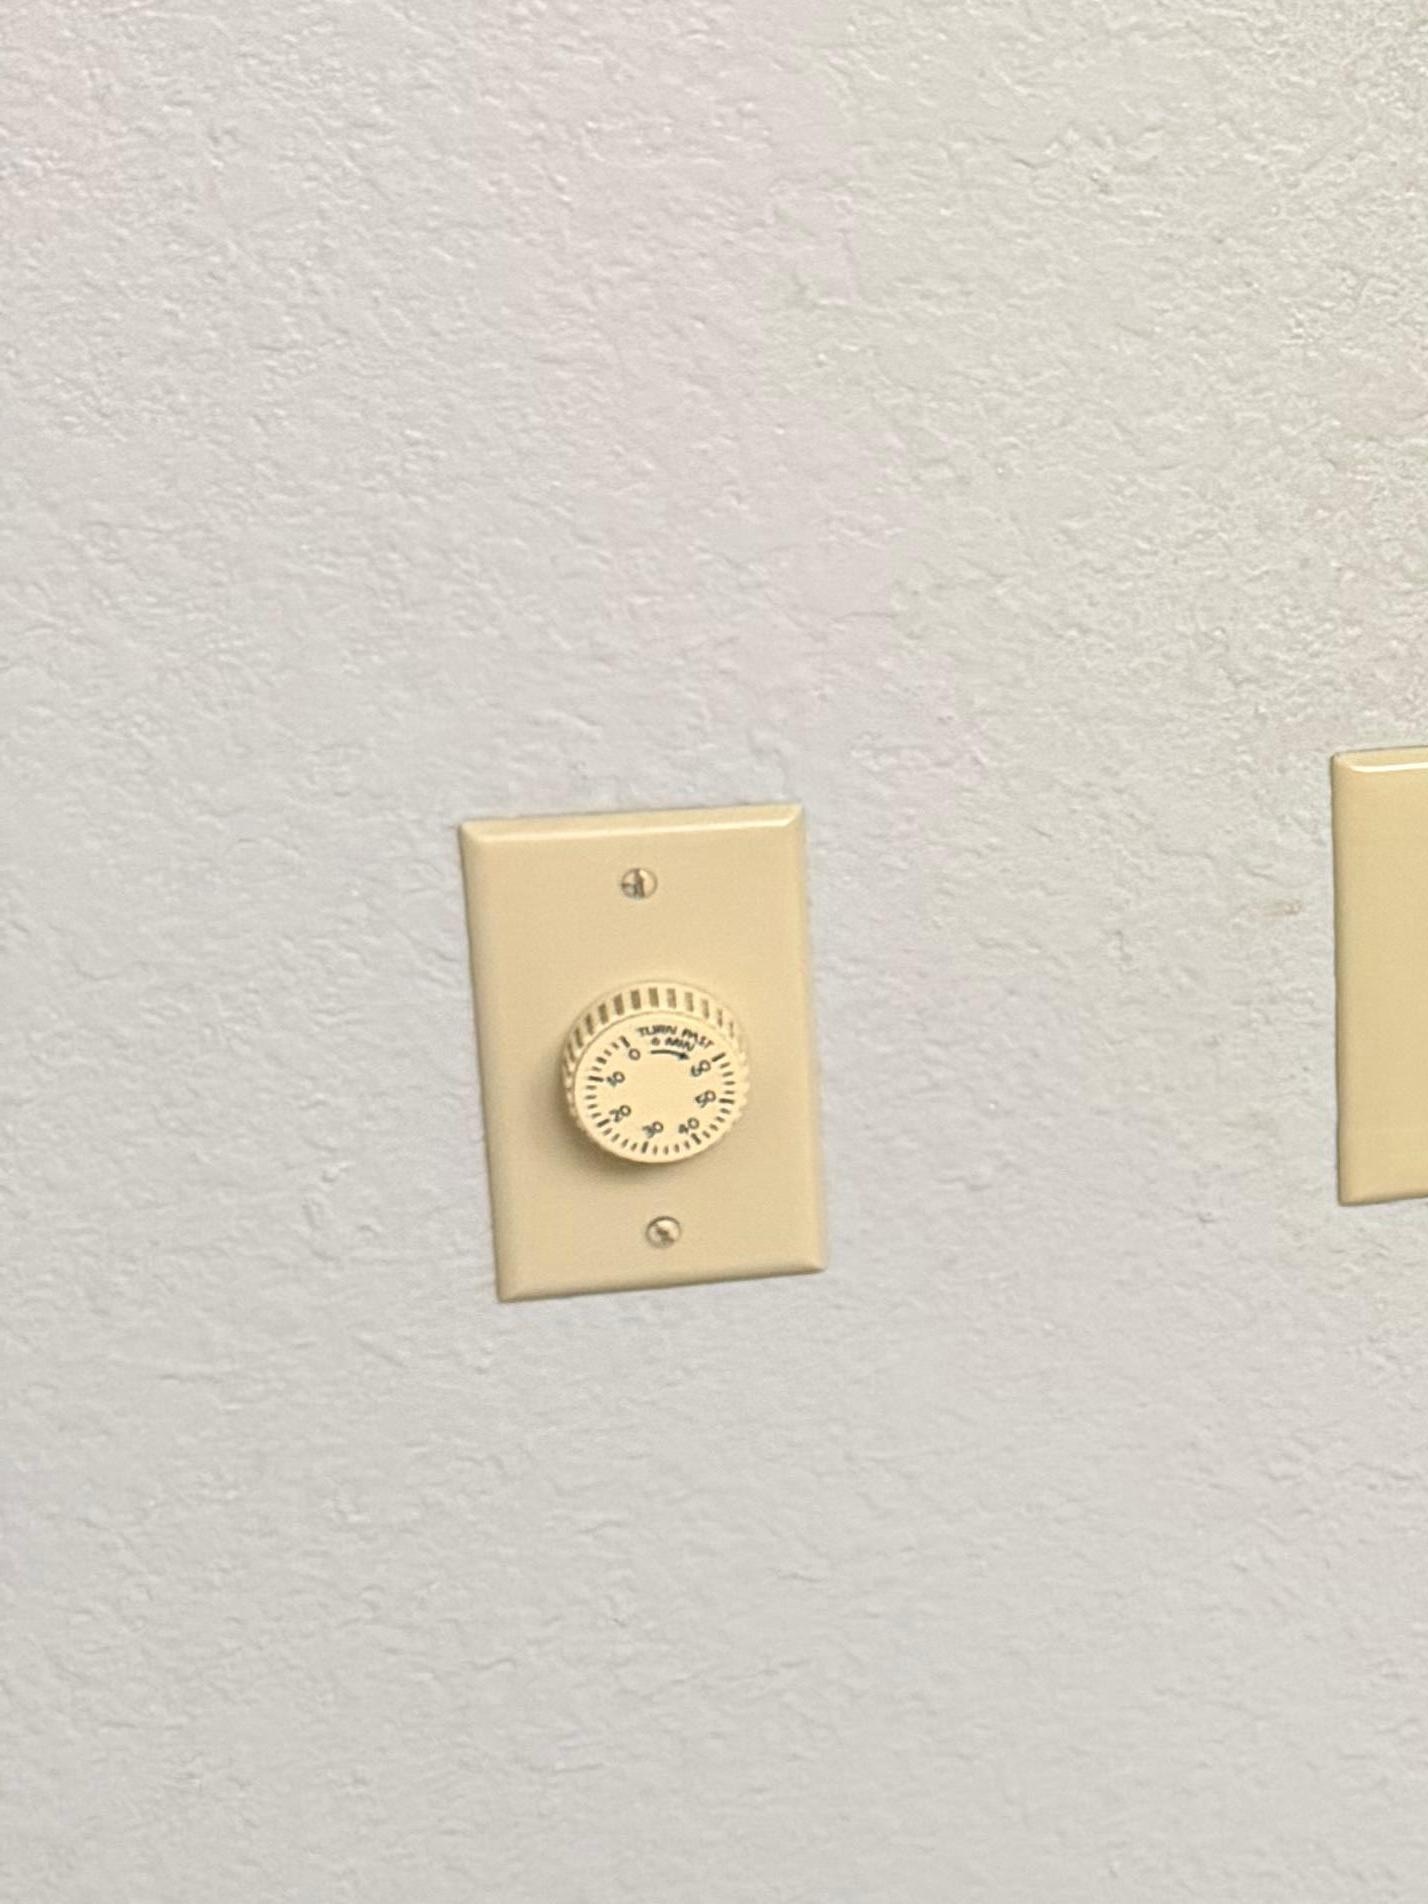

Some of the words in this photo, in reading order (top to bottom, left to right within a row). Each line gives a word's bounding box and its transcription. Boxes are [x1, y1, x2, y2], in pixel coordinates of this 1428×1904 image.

[637, 1024, 678, 1036] TURN
[681, 1028, 714, 1049] PAST
[665, 1037, 695, 1051] MIN
[628, 1048, 641, 1061] 0
[690, 1059, 711, 1077] 60
[606, 1071, 625, 1087] 10
[695, 1090, 717, 1108] 50
[609, 1104, 632, 1123] 20
[642, 1121, 664, 1139] 30
[678, 1117, 700, 1134] 40
